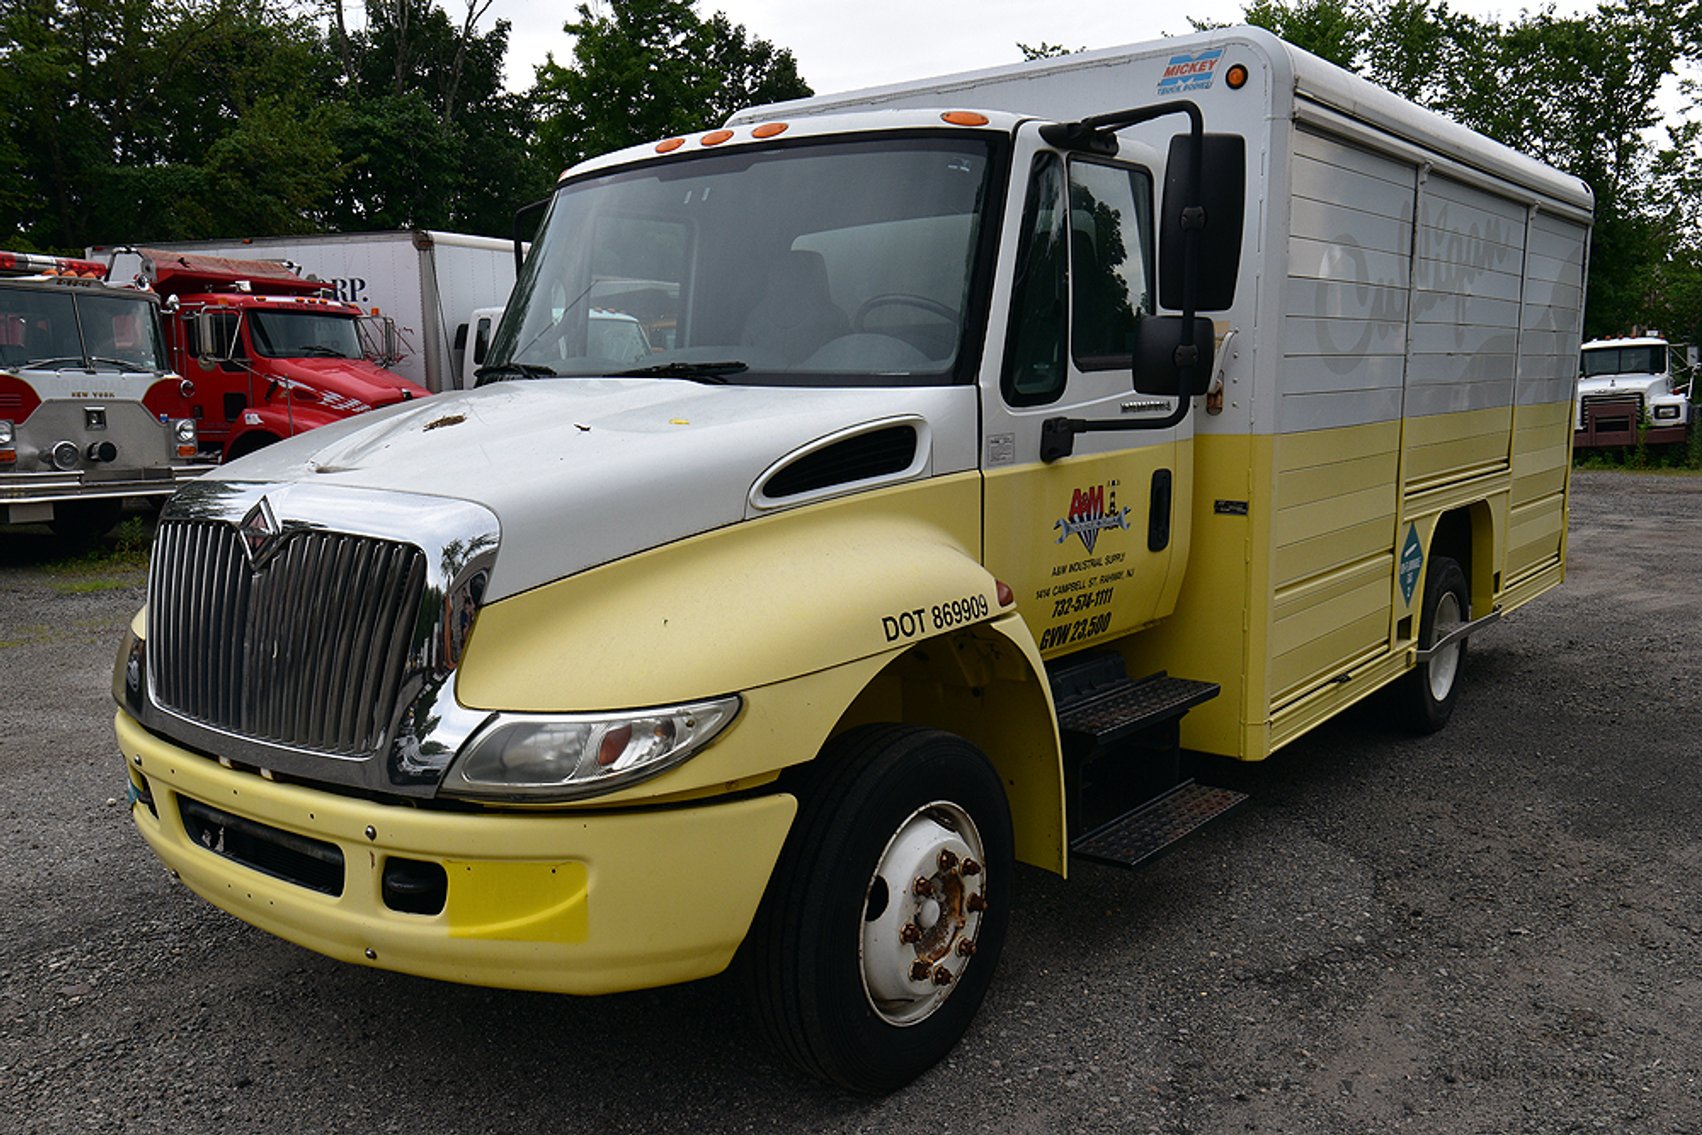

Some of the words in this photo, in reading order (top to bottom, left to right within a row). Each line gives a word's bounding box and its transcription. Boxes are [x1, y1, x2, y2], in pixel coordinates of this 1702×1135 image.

[1163, 58, 1218, 78] MICKEY
[1068, 485, 1104, 523] A&M
[1068, 557, 1103, 573] INDUSTRIAL
[1052, 580, 1086, 596] CAMPBELL
[1052, 587, 1114, 618] 732-574-1111
[881, 608, 926, 642] DOT
[931, 593, 990, 630] 869909
[1040, 621, 1071, 650] GVW
[1069, 611, 1112, 643] 23,500
